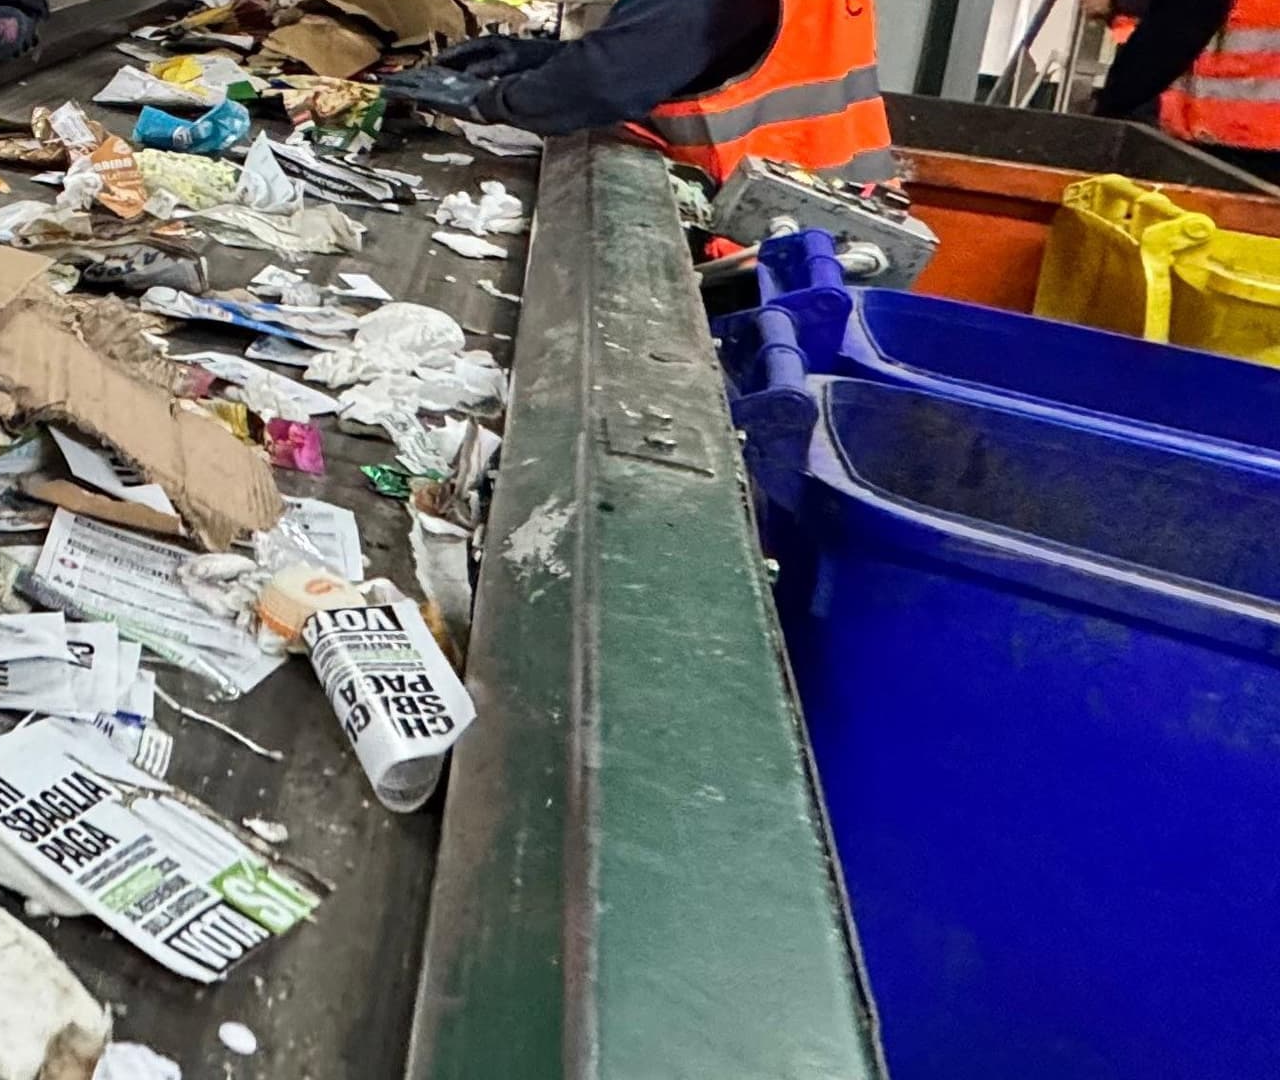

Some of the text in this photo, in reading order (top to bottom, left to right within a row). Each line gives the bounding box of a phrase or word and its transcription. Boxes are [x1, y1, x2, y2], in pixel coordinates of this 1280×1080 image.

[0, 771, 112, 843] SBAGLIA
[36, 819, 120, 874] PAGA
[171, 904, 270, 971] VOTA
